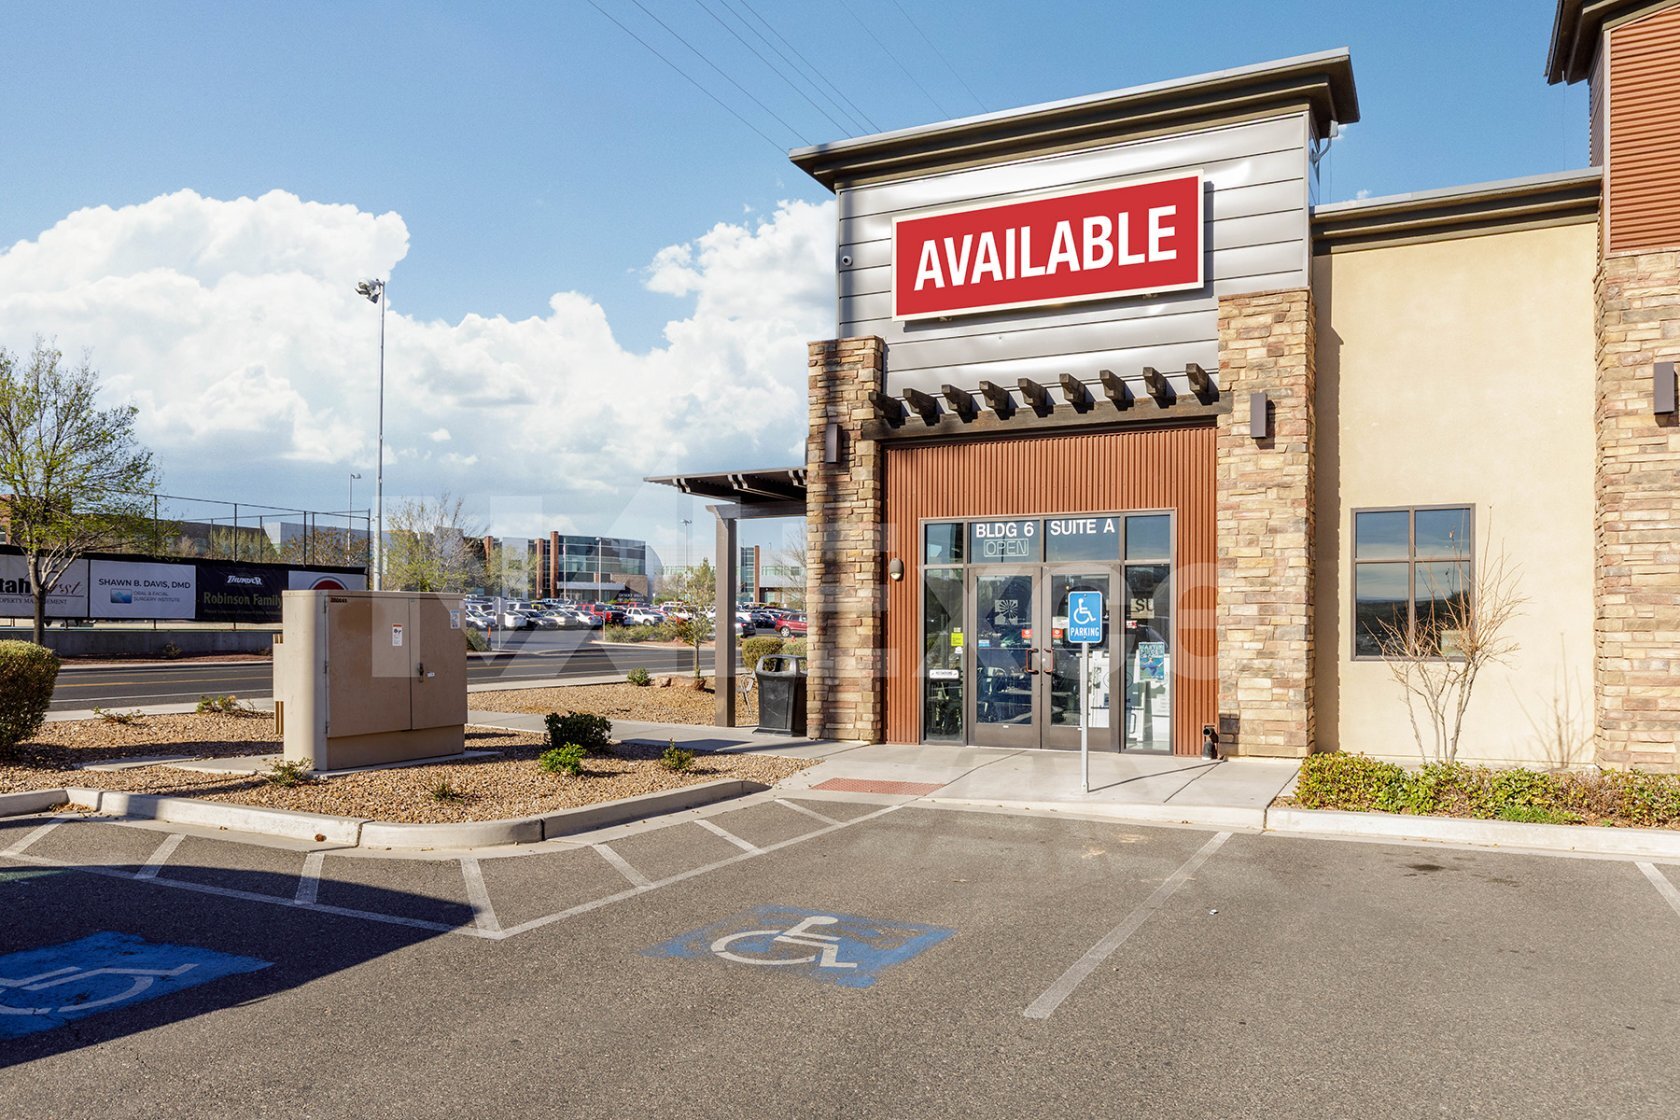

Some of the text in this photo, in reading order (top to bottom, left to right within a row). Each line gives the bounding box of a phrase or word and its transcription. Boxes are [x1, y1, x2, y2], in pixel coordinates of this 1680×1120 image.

[914, 205, 1177, 291] AVAILABLE
[976, 518, 1116, 538] BLDG 6 SUITE A
[986, 540, 1027, 555] OPEN
[98, 578, 132, 587] SHAWN
[143, 581, 170, 589] DAVIS,
[171, 581, 191, 589] DMD
[204, 592, 282, 609] Robinson Family
[1070, 627, 1100, 637] PARKING
